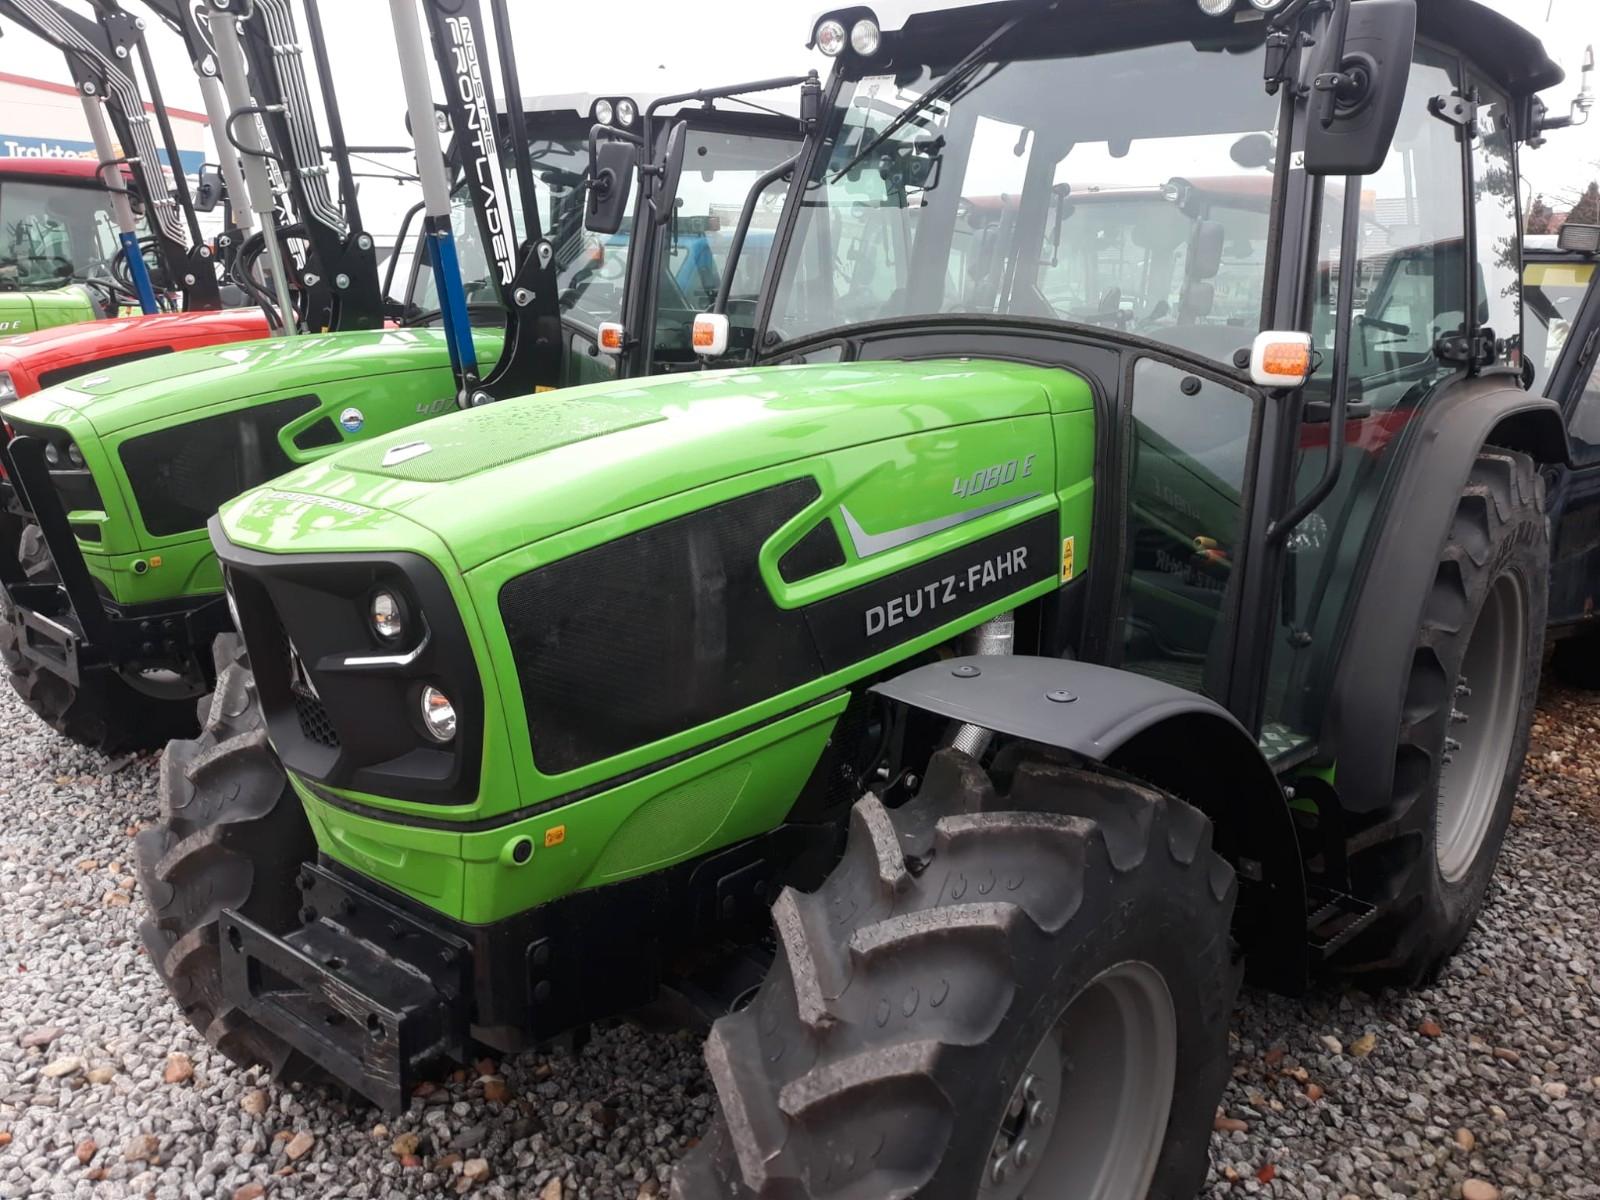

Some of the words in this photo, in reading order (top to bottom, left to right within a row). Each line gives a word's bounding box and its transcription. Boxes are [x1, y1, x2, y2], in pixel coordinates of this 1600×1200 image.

[460, 16, 495, 154] INDUSTRIE
[4, 140, 84, 159] Trakto
[445, 17, 513, 286] FRONTLADER
[952, 460, 1018, 498] 4080
[1022, 453, 1036, 478] E
[865, 546, 1028, 637] DEUTZ-FAHR
